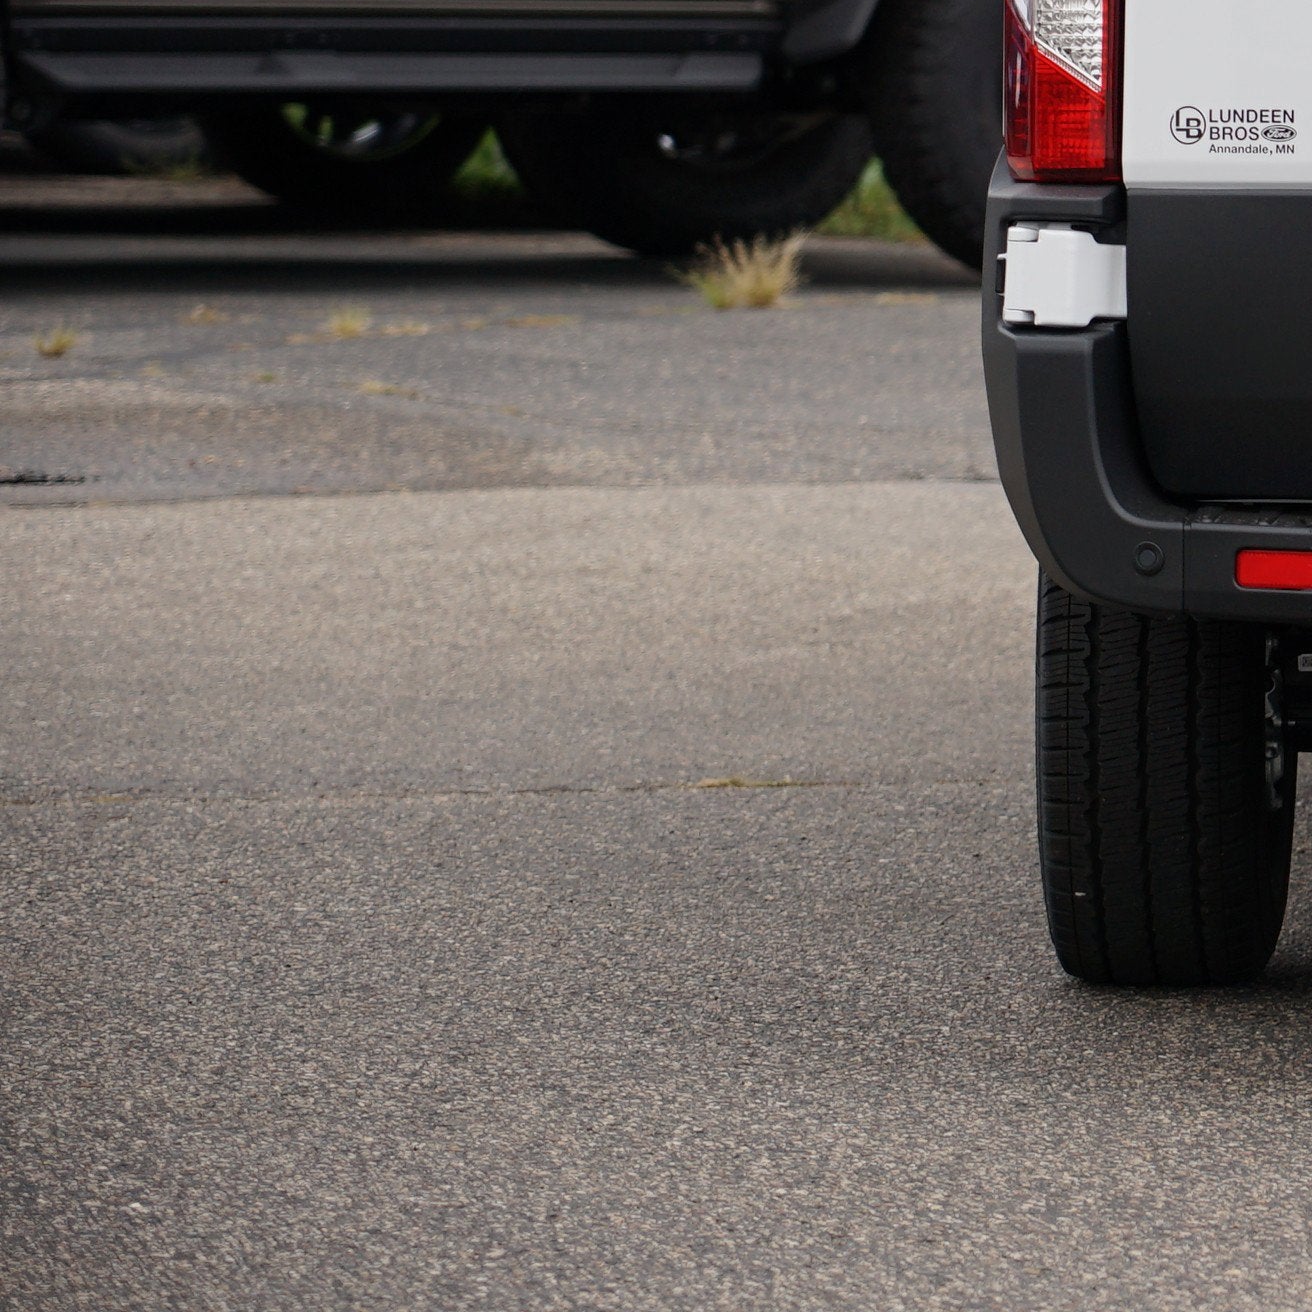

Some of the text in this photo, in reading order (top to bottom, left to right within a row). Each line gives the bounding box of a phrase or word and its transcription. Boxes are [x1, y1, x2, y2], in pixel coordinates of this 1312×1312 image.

[1208, 109, 1295, 124] LUNDEEN
[1209, 126, 1260, 141] BROS
[1208, 144, 1295, 156] Annandale, MN
